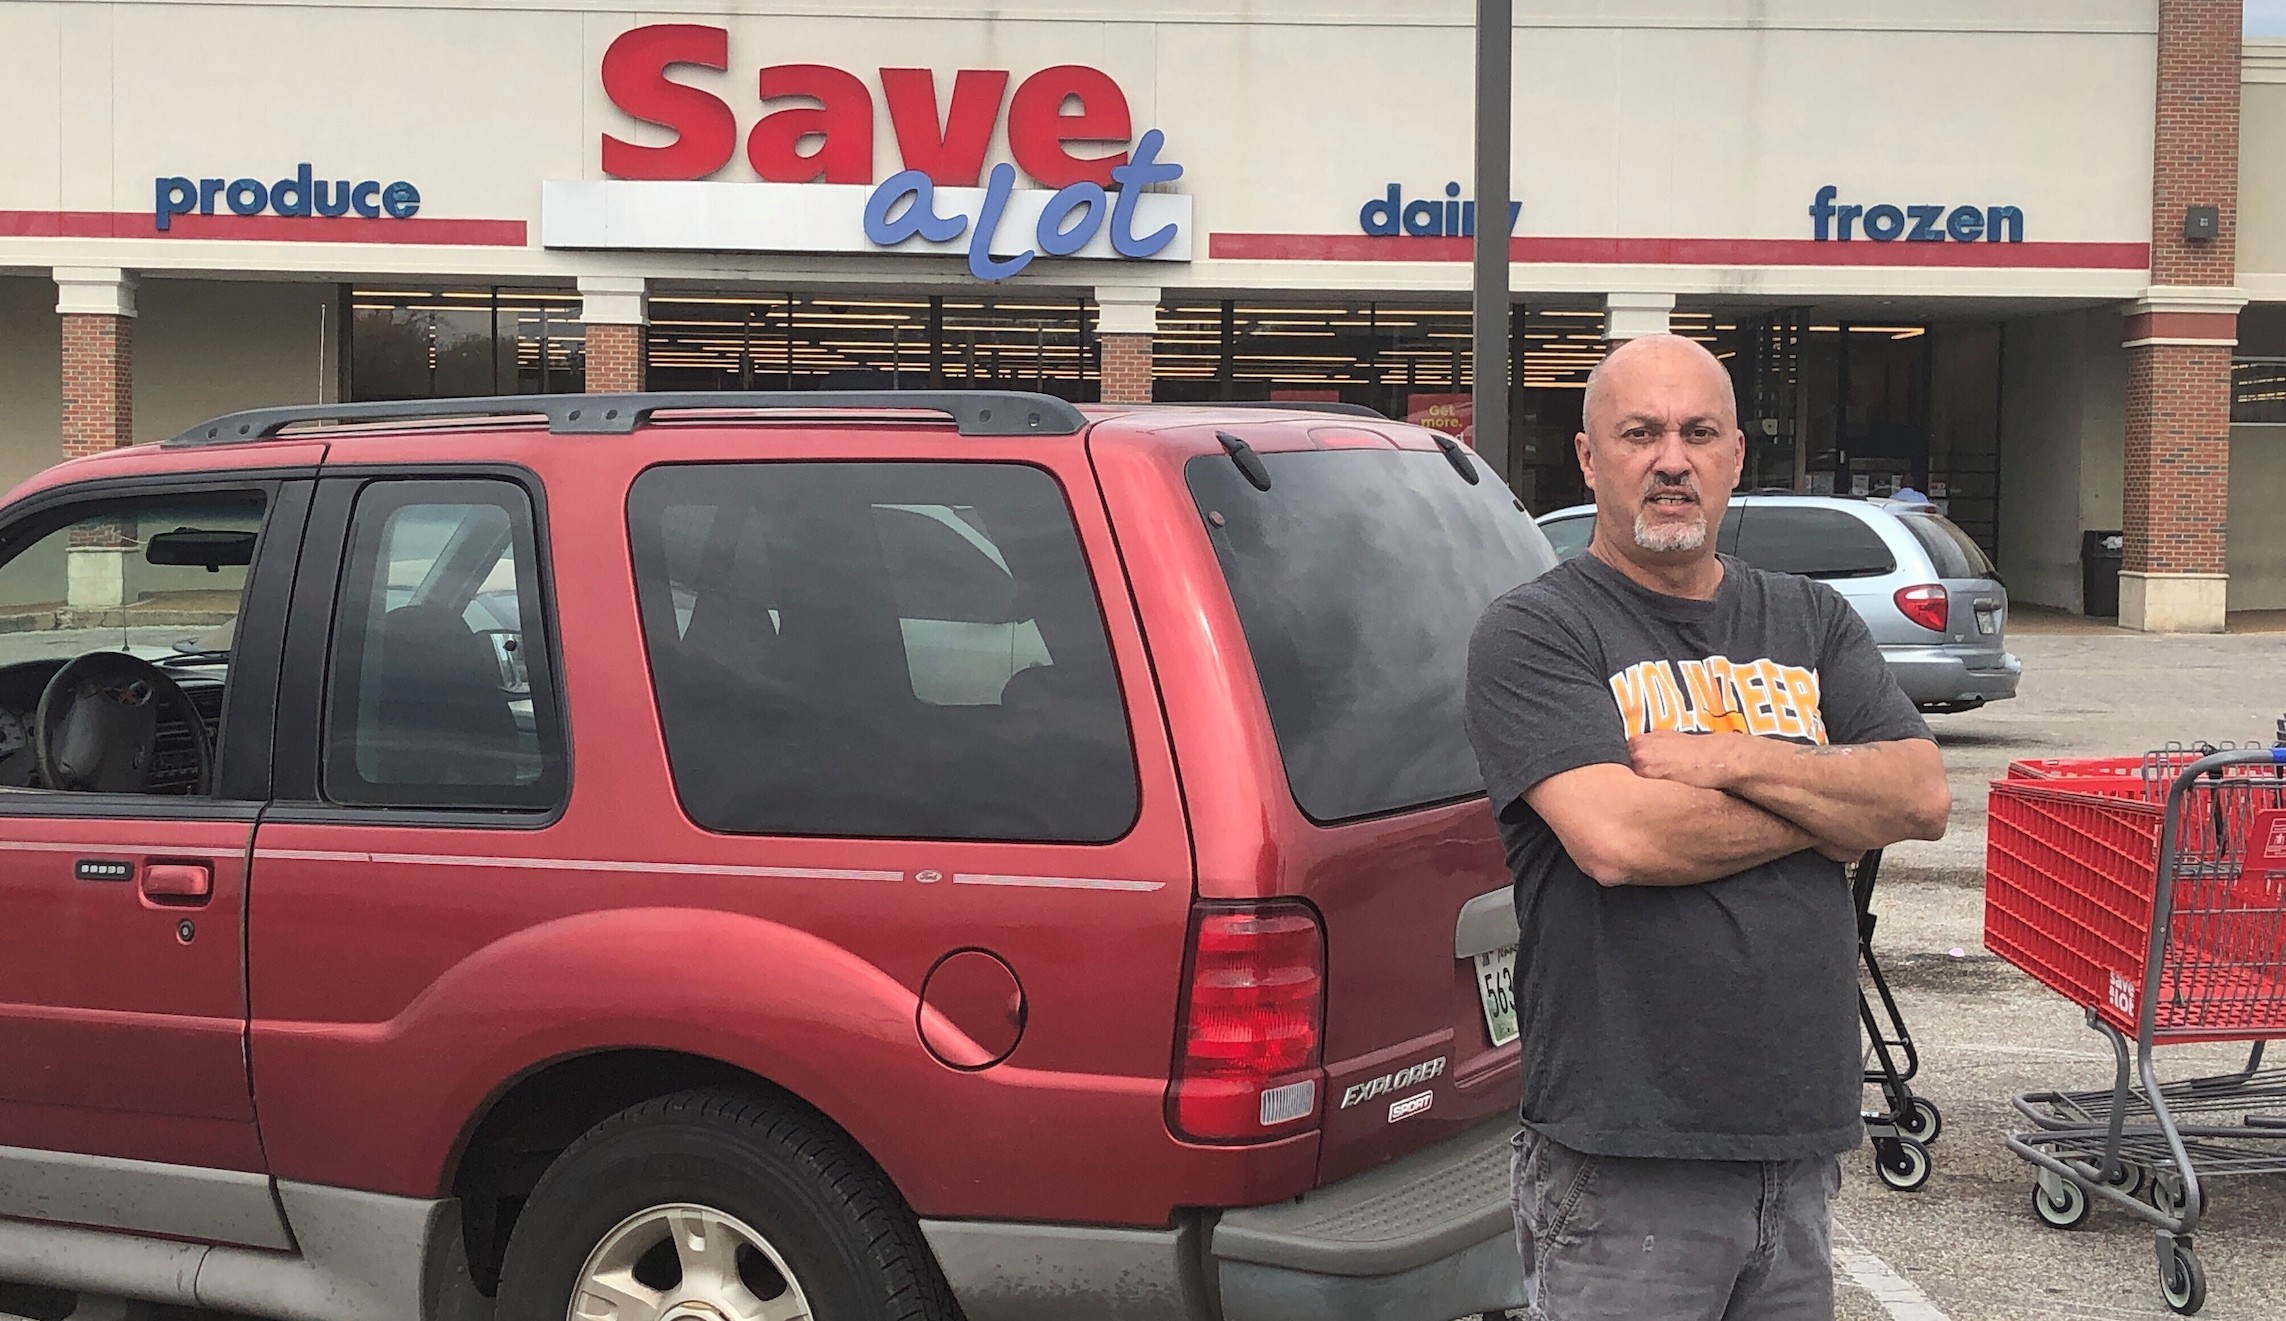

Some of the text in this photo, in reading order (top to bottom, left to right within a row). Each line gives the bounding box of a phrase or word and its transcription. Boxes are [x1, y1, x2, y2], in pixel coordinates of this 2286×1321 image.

[601, 23, 1133, 190] Save
[155, 163, 421, 231] produce
[1359, 181, 1523, 237] dair
[1809, 185, 2024, 243] frozen
[1429, 404, 1456, 416] Get
[1340, 1056, 1447, 1109] EXPLORER
[1391, 1095, 1431, 1118] SPORT
